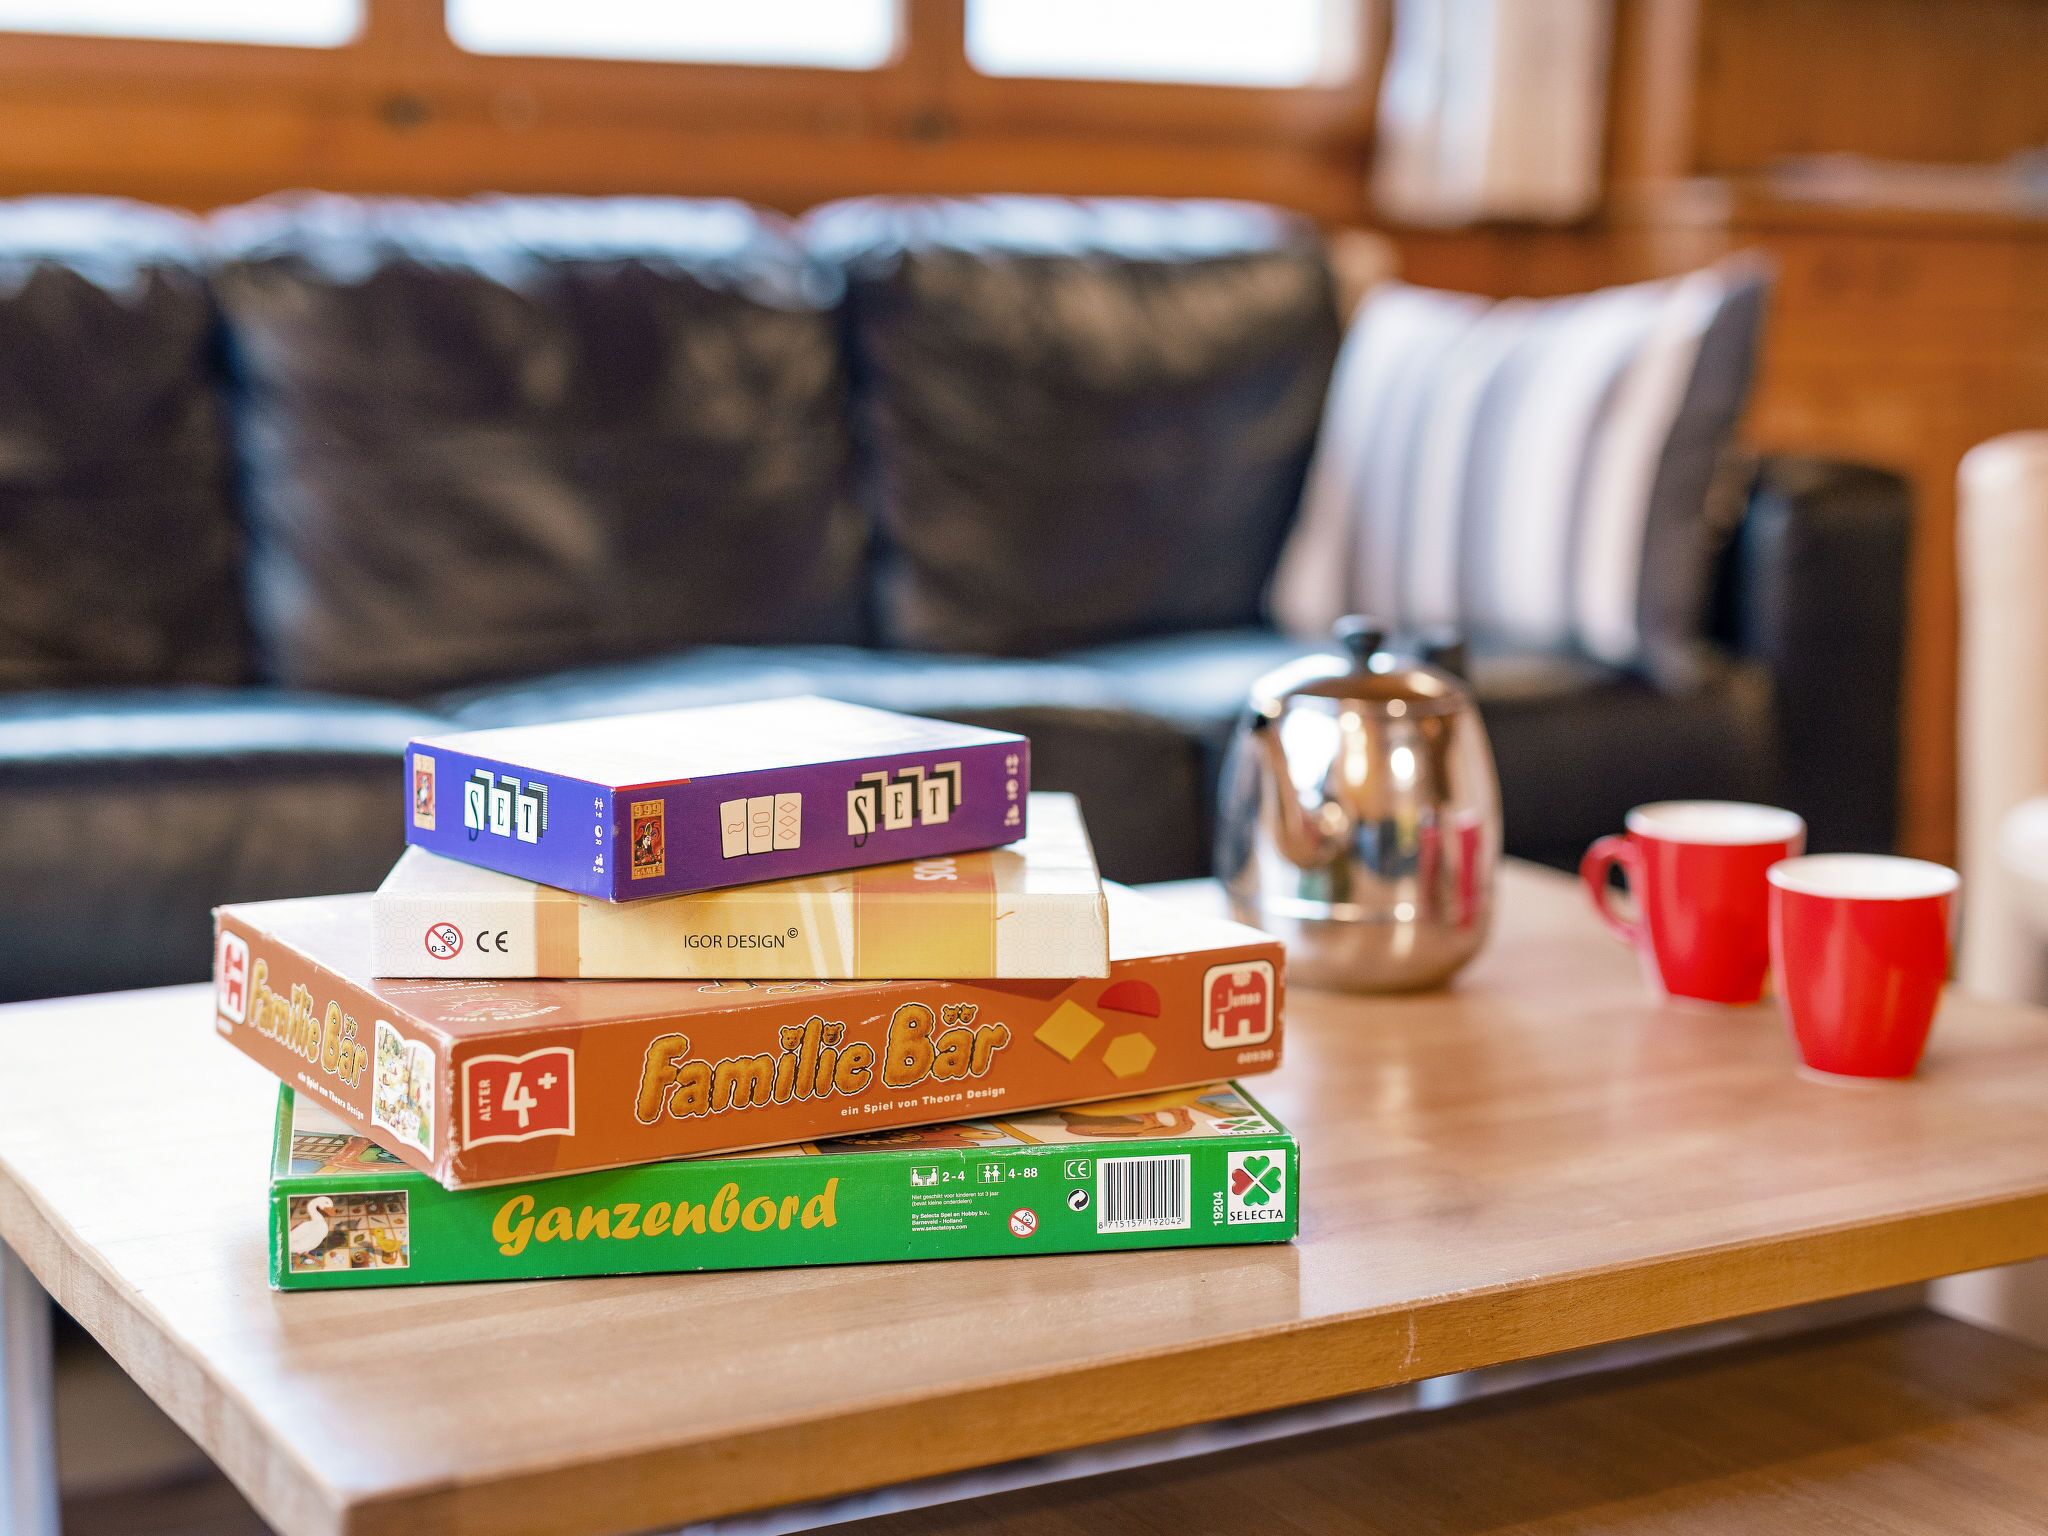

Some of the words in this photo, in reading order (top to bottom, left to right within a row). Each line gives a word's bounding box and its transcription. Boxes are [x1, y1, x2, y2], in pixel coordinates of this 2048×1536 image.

[634, 803, 662, 817] 999
[431, 945, 446, 953] 0-3
[684, 934, 722, 949] IGOR
[248, 957, 322, 1063] Familie
[320, 1000, 368, 1088] Bär
[635, 1014, 876, 1124] Familie
[881, 1002, 1012, 1088] Bär
[479, 1078, 492, 1122] ALTER
[501, 1071, 558, 1129] 4+
[840, 1106, 859, 1117] ein
[863, 1101, 894, 1114] Spiel
[897, 1098, 918, 1109] von
[922, 1093, 963, 1105] Theora
[966, 1087, 1006, 1099] Design
[491, 1176, 840, 1257] Ganzenbord
[1098, 1221, 1104, 1229] 8
[1108, 1219, 1143, 1228] 715157
[1148, 1217, 1182, 1226] 192042
[1212, 1191, 1224, 1227] 19204
[1229, 1209, 1284, 1221] SELECTA
[1013, 1224, 1025, 1232] 0-3
